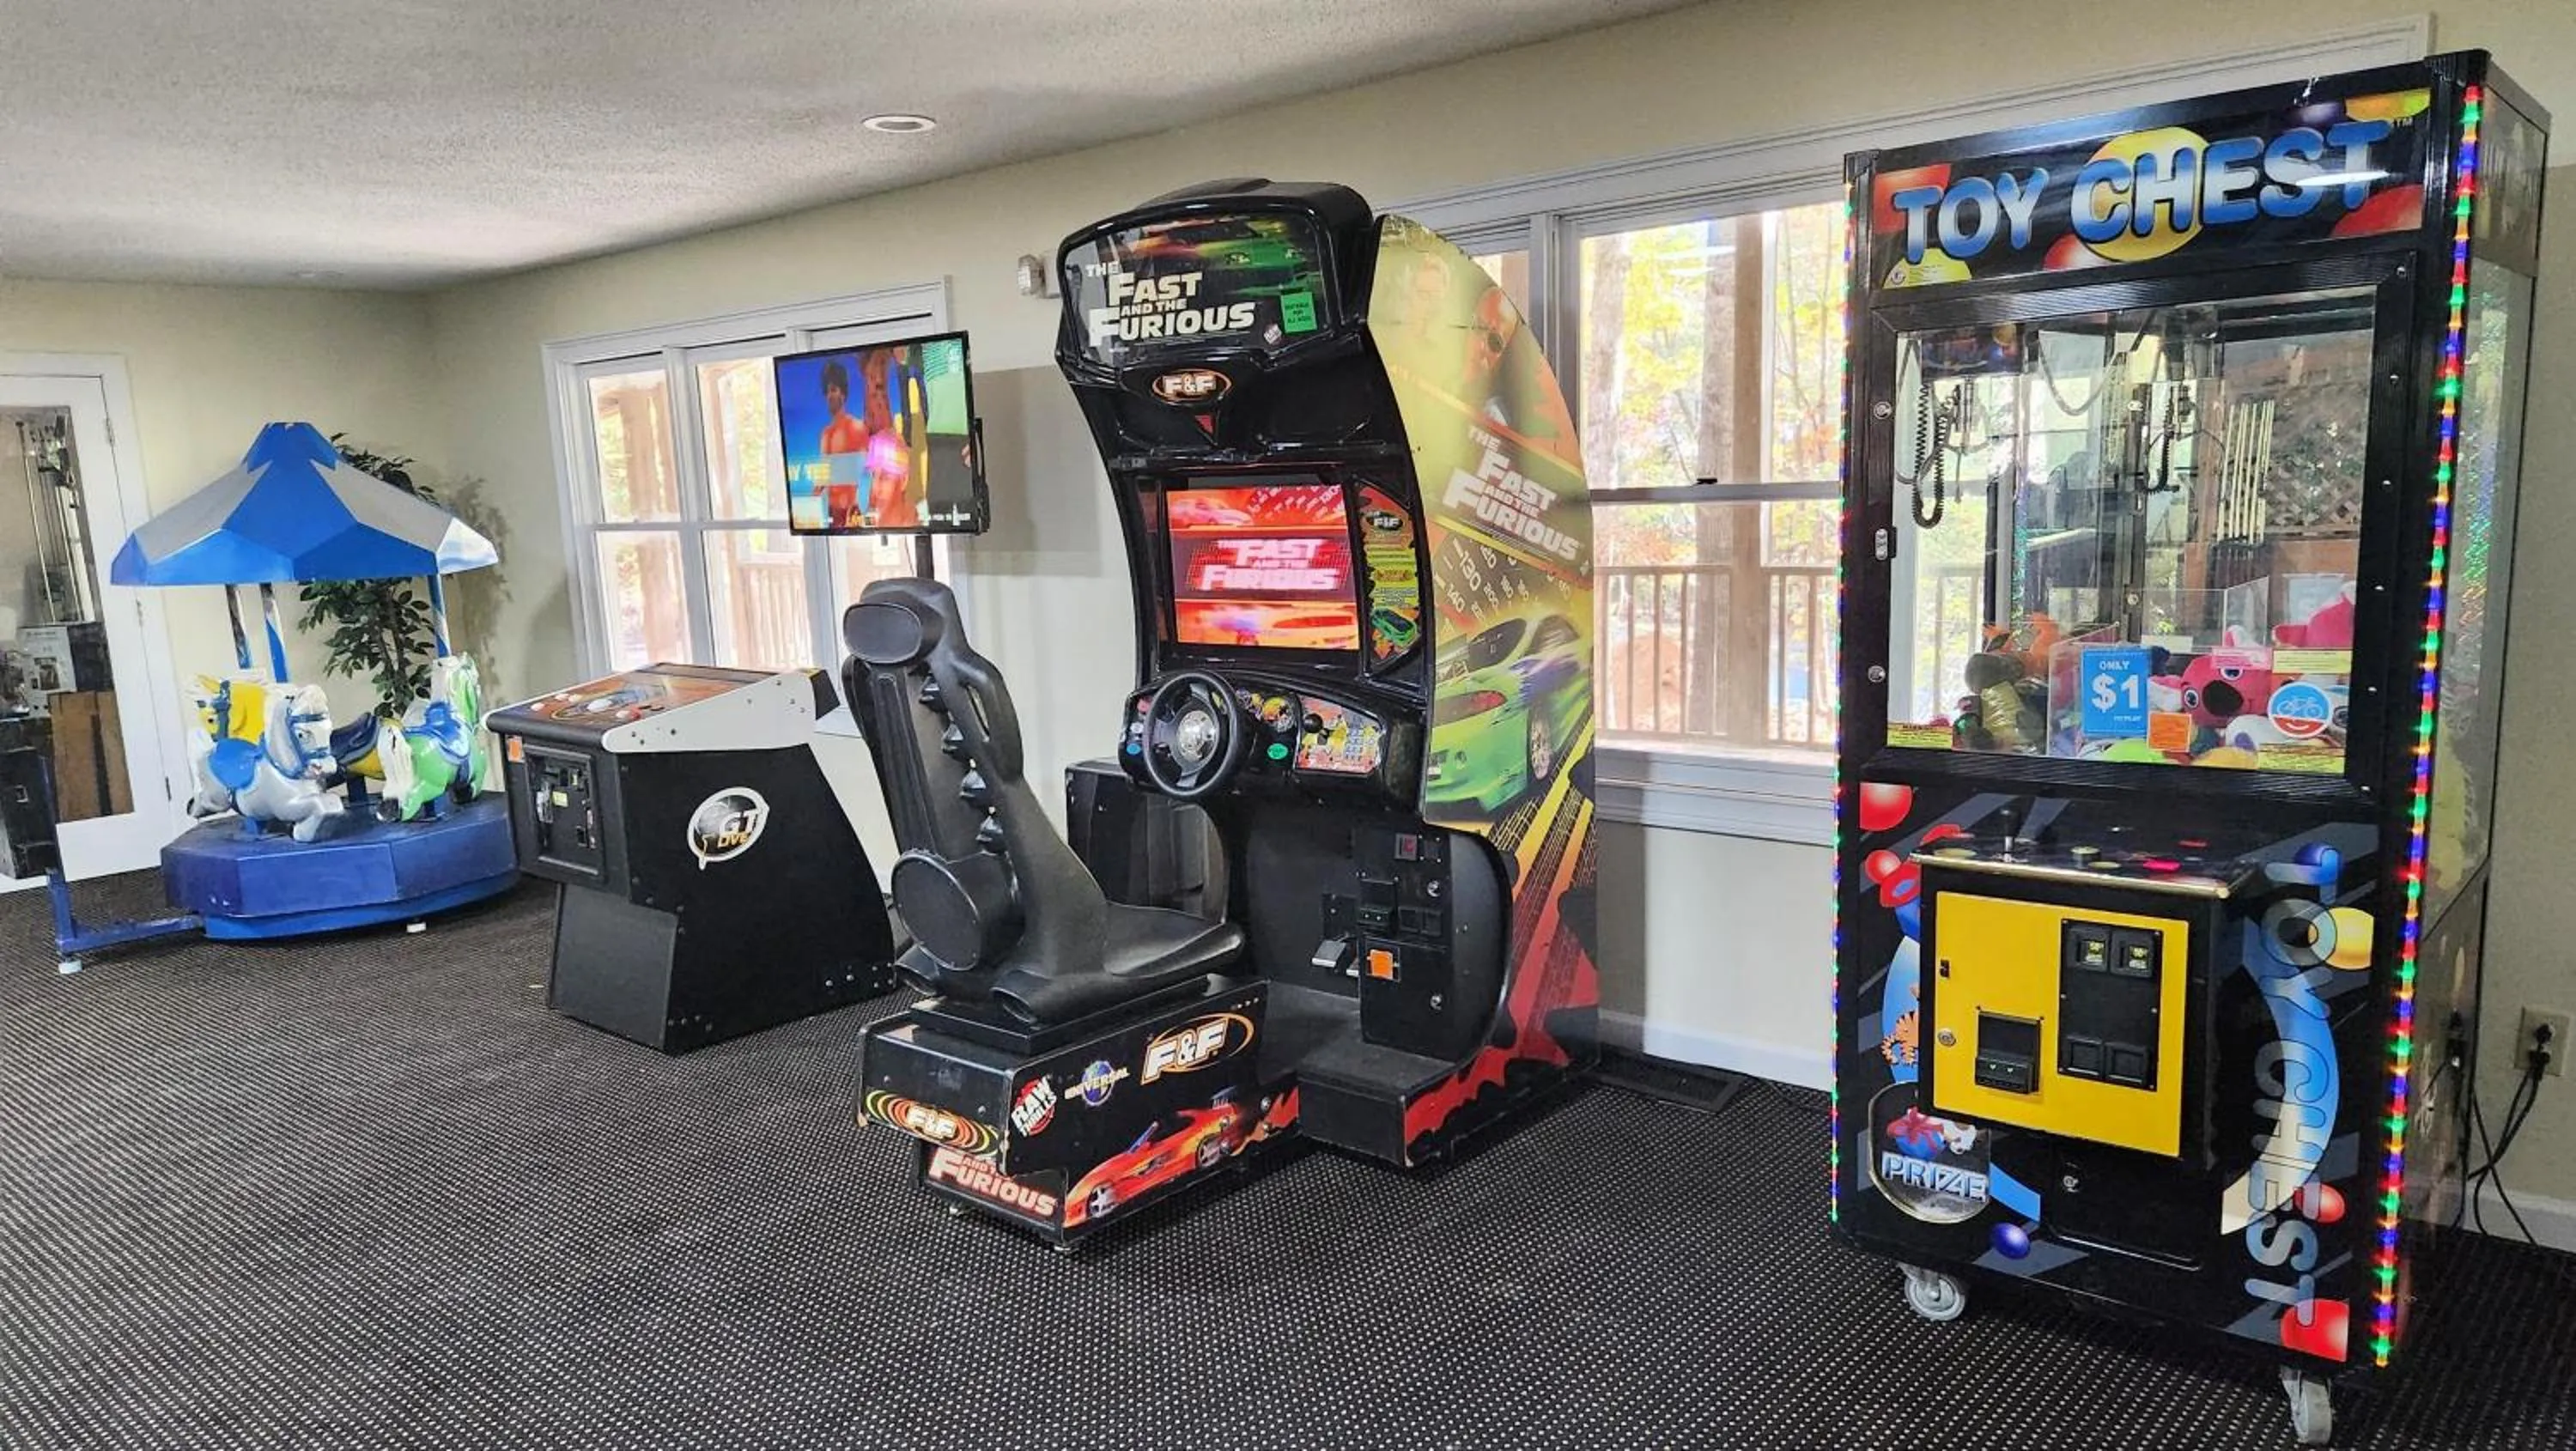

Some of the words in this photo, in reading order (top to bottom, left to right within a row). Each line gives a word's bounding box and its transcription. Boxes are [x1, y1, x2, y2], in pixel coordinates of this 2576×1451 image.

[1894, 167, 2050, 265] TOY
[2069, 119, 2392, 244] CHEST
[1085, 261, 1121, 277] THE
[1109, 271, 1203, 306] FAST
[1089, 302, 1256, 347] FURIOUS
[1121, 301, 1152, 317] AND
[1153, 298, 1188, 312] THE
[1162, 374, 1218, 396] F&F
[1475, 449, 1558, 512] FAST
[1442, 467, 1583, 561] FURIOUS
[1459, 550, 1482, 592] 130
[2099, 660, 2130, 671] ONLY
[2092, 673, 2139, 713] $1
[2262, 847, 2341, 1023] TOY
[1142, 1017, 1228, 1084] F&F
[907, 1104, 957, 1139] F&F
[1012, 1076, 1054, 1126] RAW
[928, 1146, 1058, 1217] FURIOUS
[1881, 1150, 1990, 1203] PRIZE
[2245, 1039, 2331, 1329] CHEST
